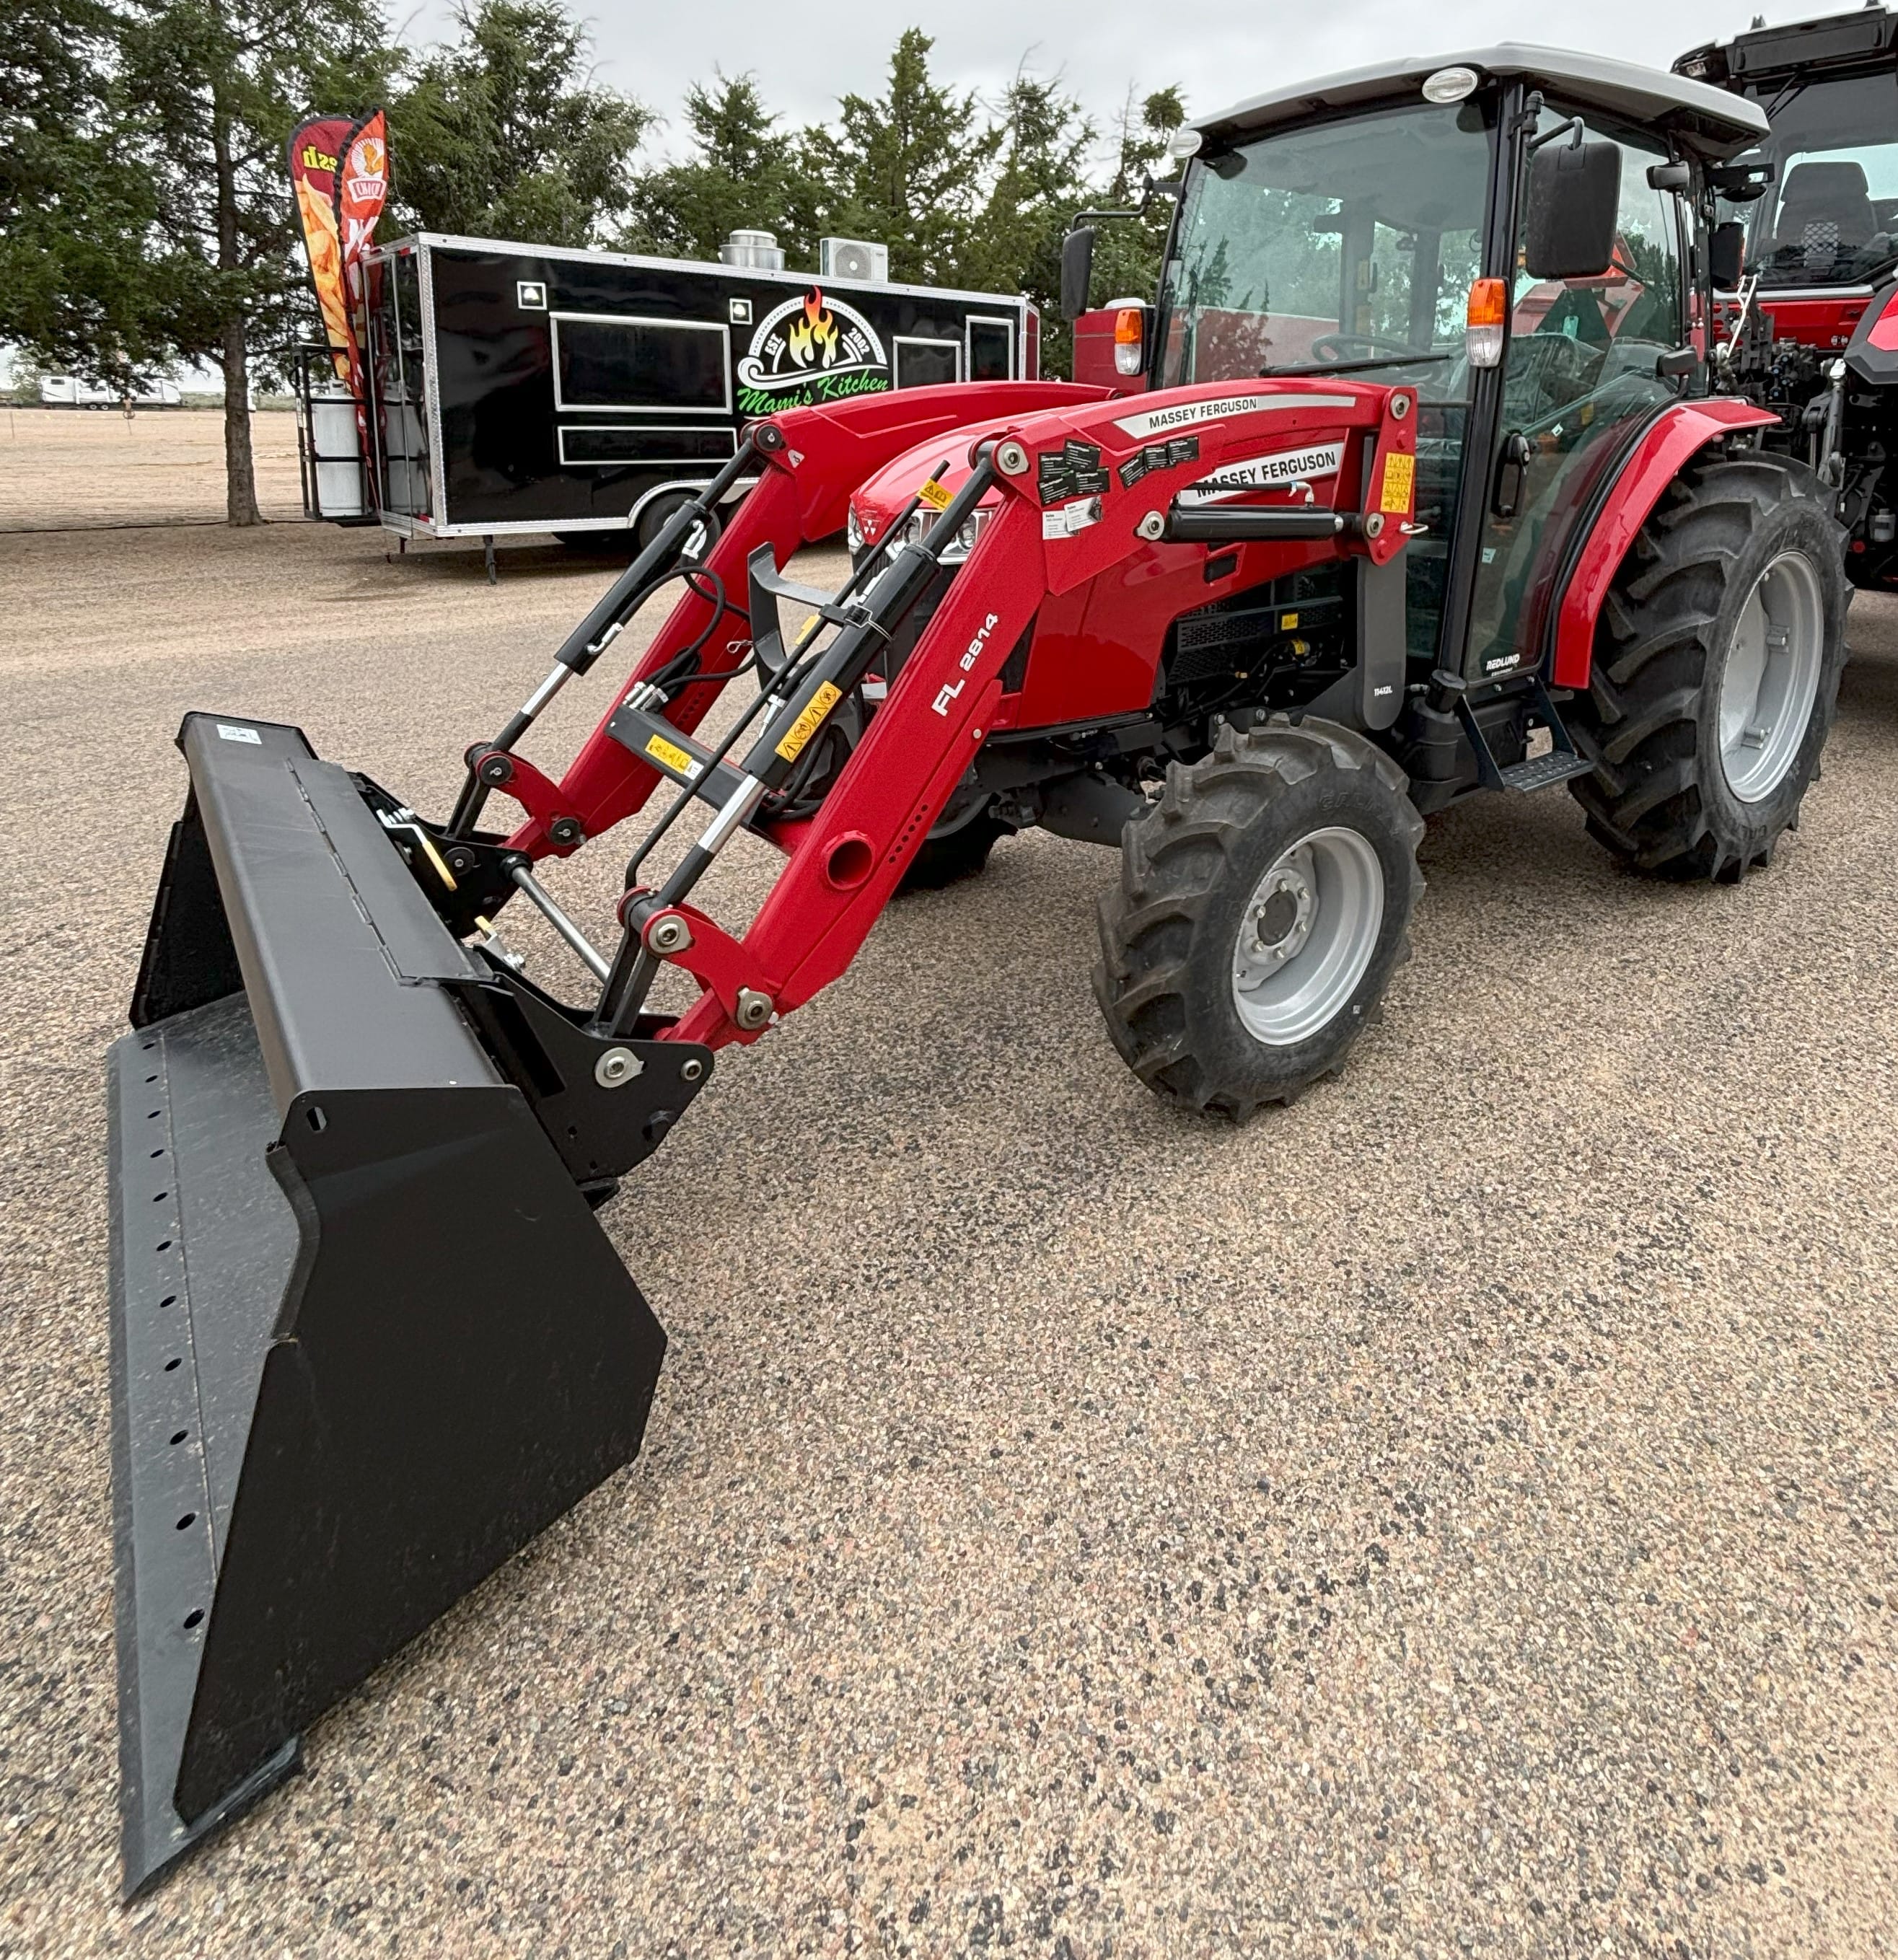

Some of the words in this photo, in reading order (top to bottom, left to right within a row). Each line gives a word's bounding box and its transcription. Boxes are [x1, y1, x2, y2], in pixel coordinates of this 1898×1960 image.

[848, 328, 870, 355] 2002
[737, 382, 814, 414] Mami's
[817, 369, 889, 401] Kitchen
[1149, 408, 1196, 429] MASSEY
[1200, 398, 1257, 417] FERGUSON
[1261, 452, 1336, 480] FERGUSON
[931, 679, 965, 717] FL
[959, 612, 998, 672] 2814
[1486, 653, 1521, 671] REDLUND
